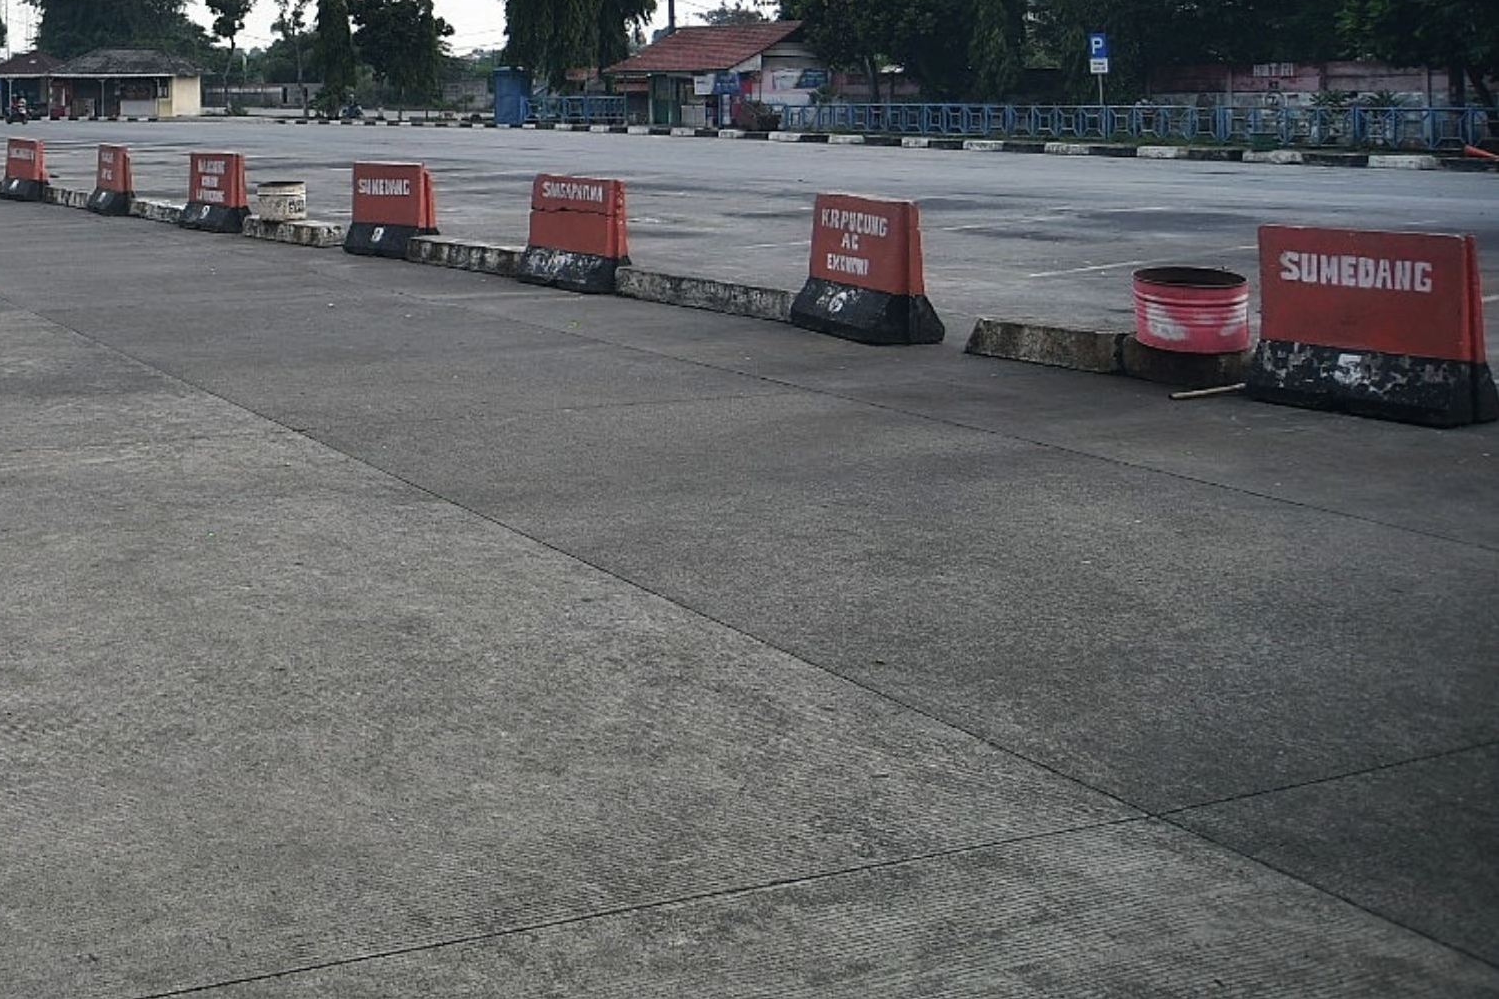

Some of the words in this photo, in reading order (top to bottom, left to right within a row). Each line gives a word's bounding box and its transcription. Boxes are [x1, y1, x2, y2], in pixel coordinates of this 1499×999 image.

[1091, 37, 1103, 54] P
[841, 232, 859, 250] AC
[1279, 251, 1432, 293] SUMEDANG
